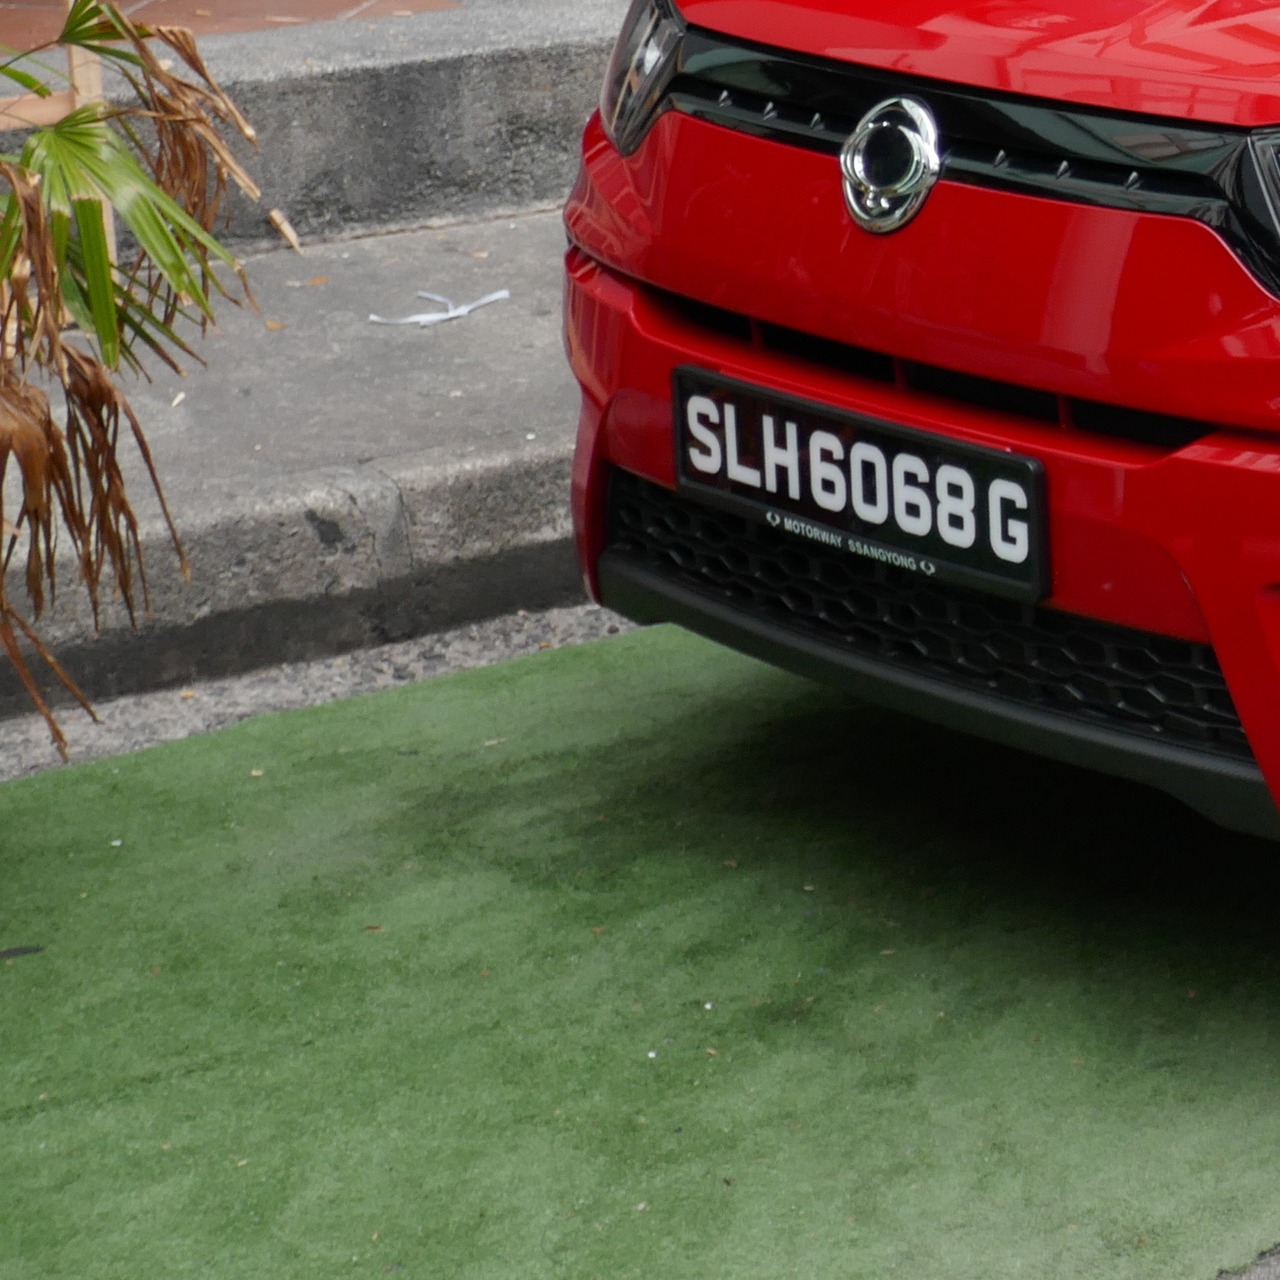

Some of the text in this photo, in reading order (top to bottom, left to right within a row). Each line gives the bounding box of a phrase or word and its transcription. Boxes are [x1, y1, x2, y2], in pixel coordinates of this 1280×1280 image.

[686, 395, 1029, 564] SLH6068G
[783, 517, 917, 572] MOTORWAY SSANGYONG
